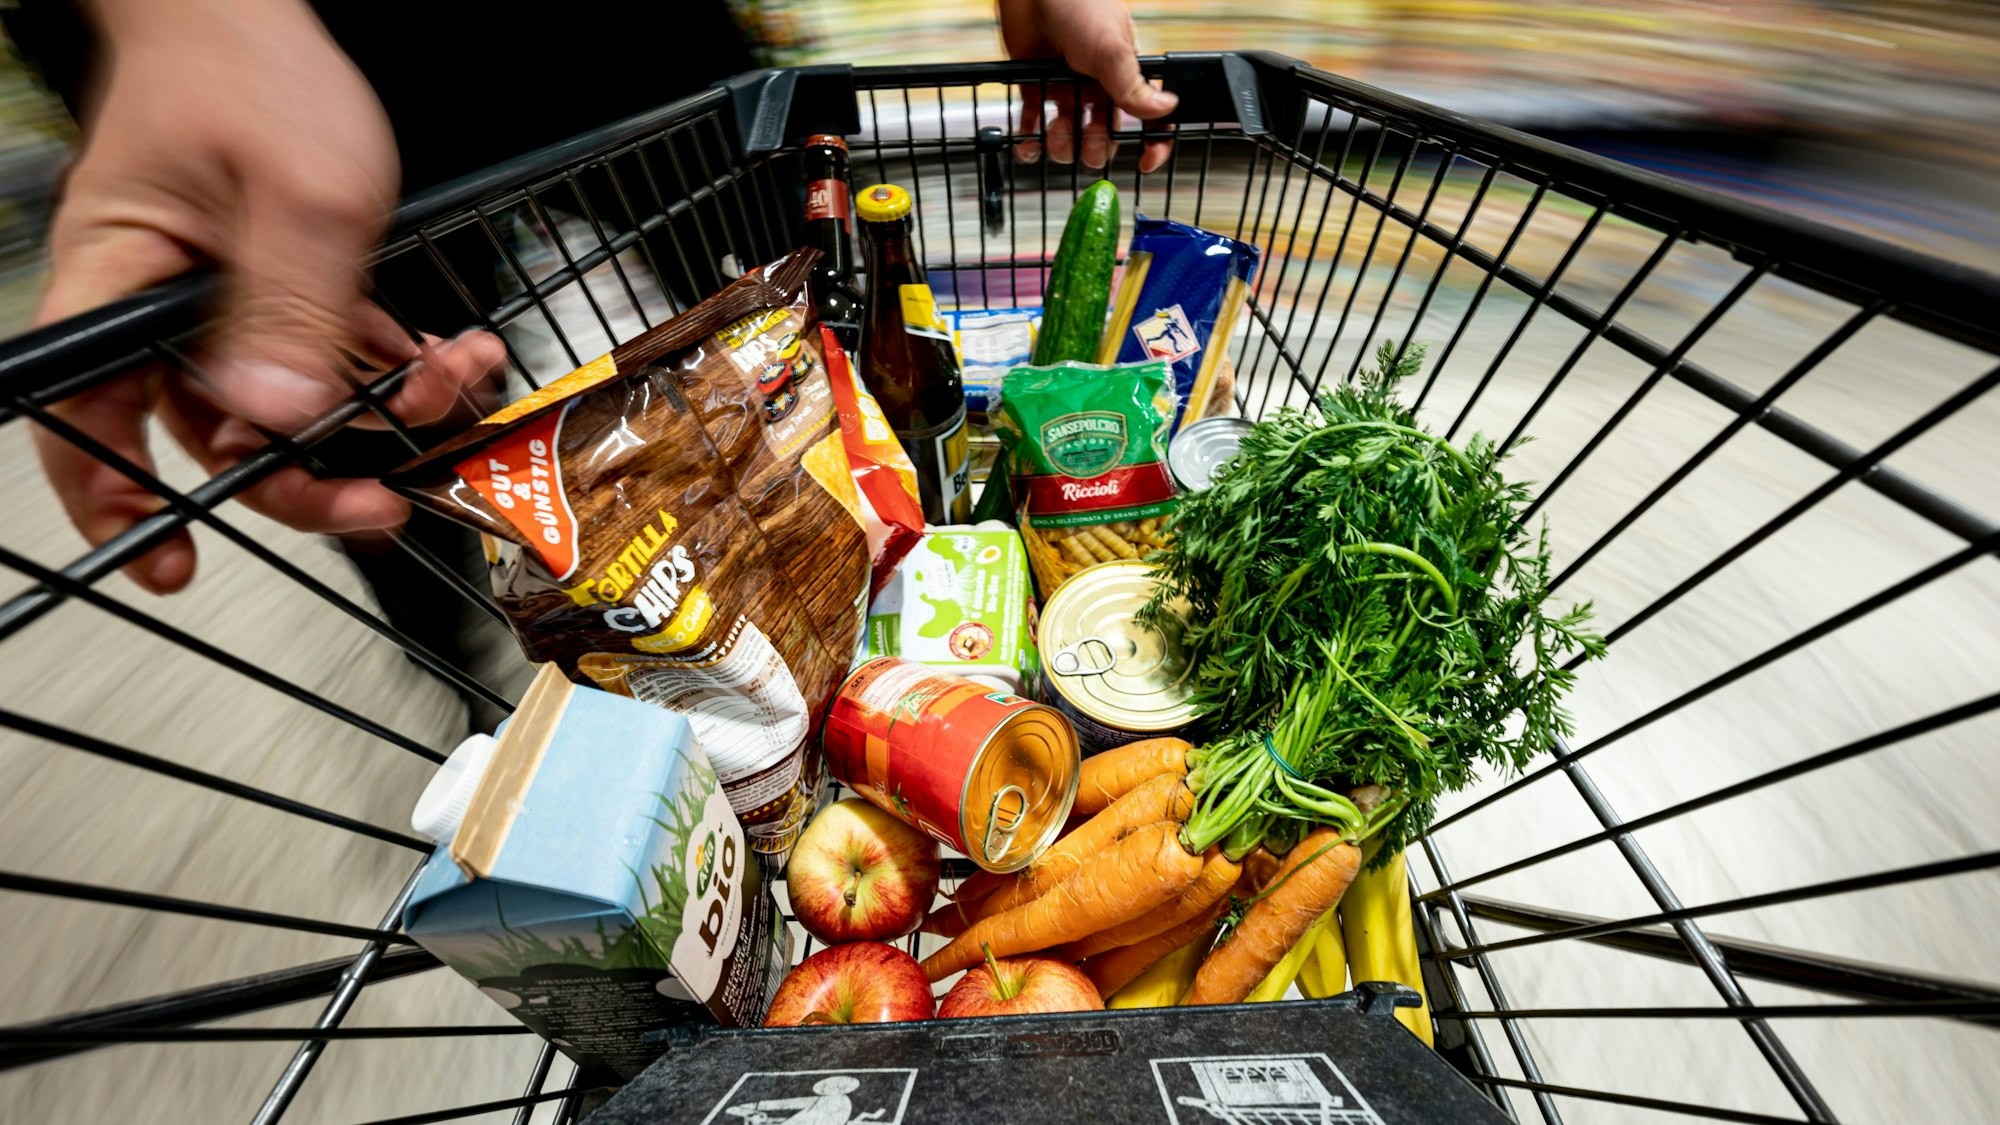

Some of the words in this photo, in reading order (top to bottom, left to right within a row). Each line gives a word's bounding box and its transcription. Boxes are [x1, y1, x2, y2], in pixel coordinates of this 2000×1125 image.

[1047, 418, 1120, 442] SANSEPOLCRO
[1058, 438, 1114, 451] FACTORY
[489, 459, 515, 509] GUT
[513, 482, 532, 501] &
[529, 438, 561, 545] GÜNSTIG
[1061, 480, 1120, 501] Riccioli
[1056, 515, 1102, 525] SELEZIONATA
[1103, 513, 1112, 521] DI
[1113, 511, 1139, 520] GRANO
[1140, 507, 1161, 516] DURO
[561, 507, 679, 607] TORTILLA
[603, 544, 696, 632] CHIPS
[700, 841, 714, 892] Arla
[699, 835, 735, 956] bio
[722, 943, 741, 1003] FRISCHE
[739, 917, 748, 940] BIO
[726, 934, 749, 1007] VOLLMILCH
